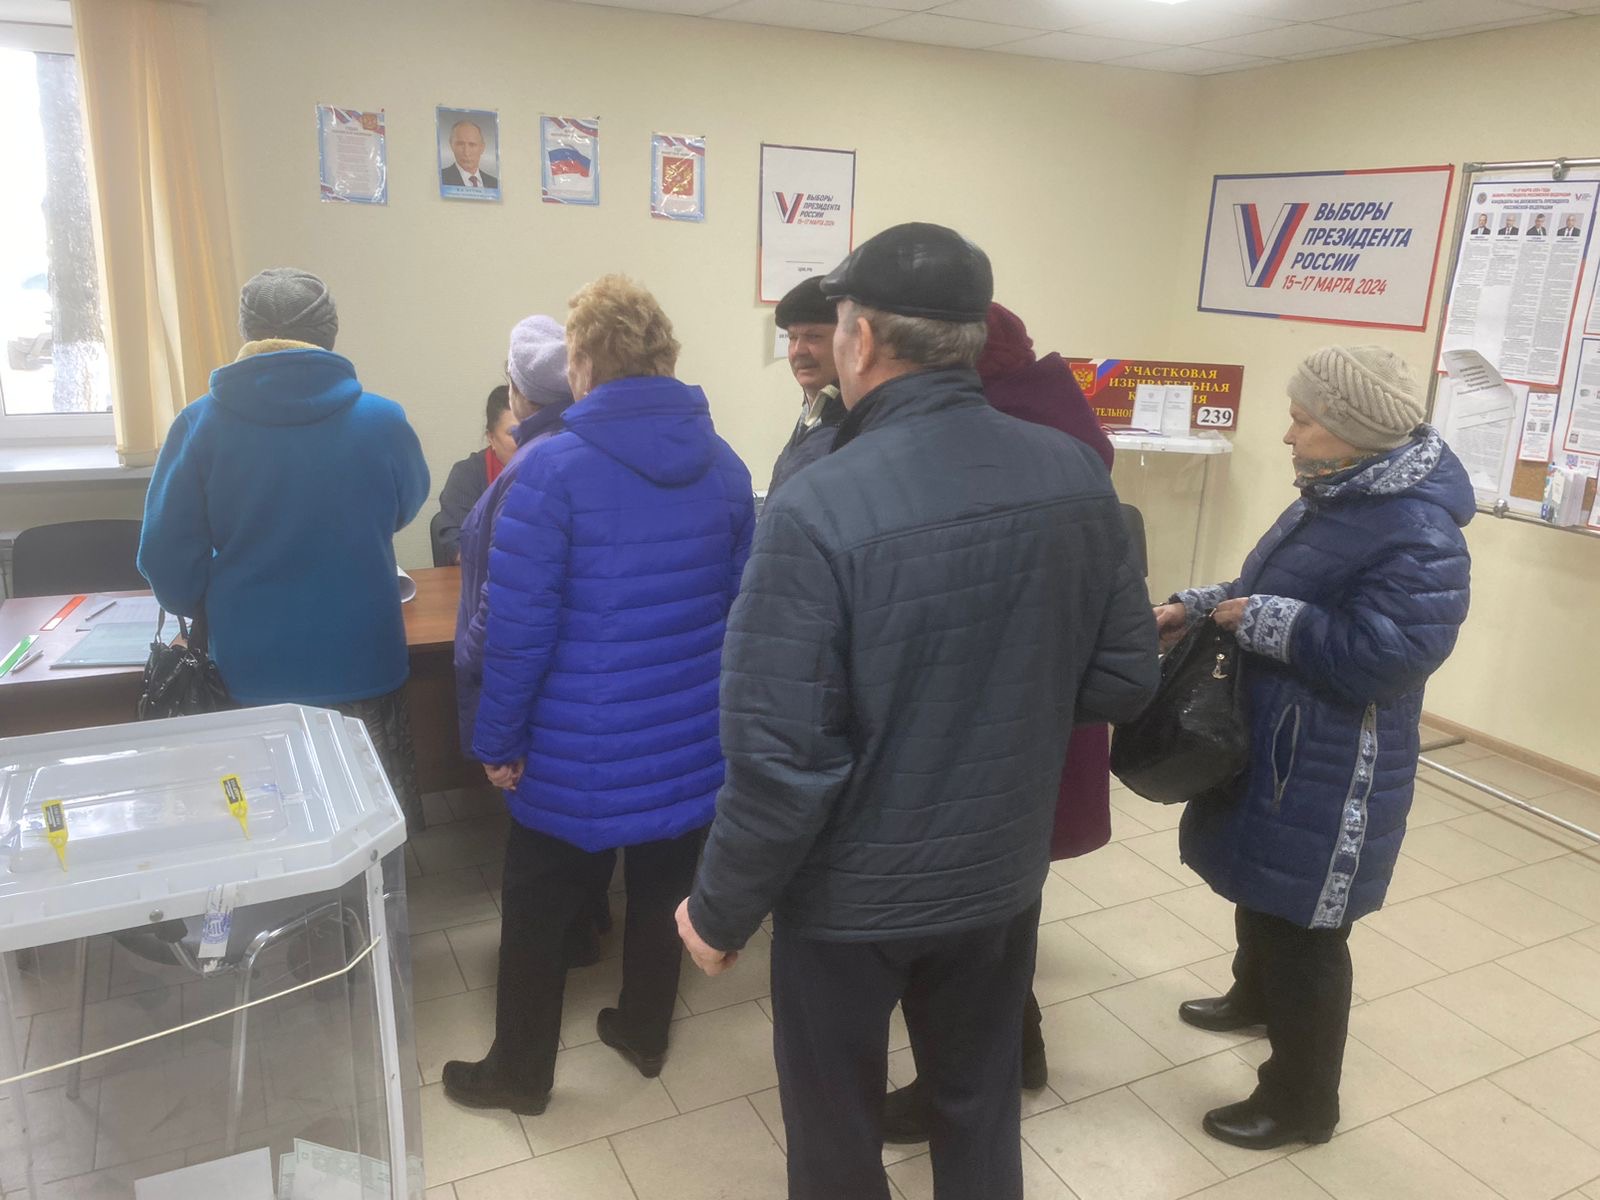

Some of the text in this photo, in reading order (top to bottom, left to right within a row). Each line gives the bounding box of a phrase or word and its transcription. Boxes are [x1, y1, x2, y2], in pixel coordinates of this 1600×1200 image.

[803, 202, 841, 211] ПРЕЗИДЕНТА
[806, 194, 834, 202] ВЫБОРЫ
[800, 210, 825, 218] РОССИИ
[1314, 202, 1393, 221] ВЫБОРЫ
[1302, 228, 1413, 249] ПРЕЗИДЕНТА
[1290, 252, 1360, 272] РОССИИ
[1317, 277, 1354, 294] МАРТА
[1354, 279, 1388, 295] 2024
[1124, 365, 1217, 379] УЧАСТКОВАЯ
[1200, 408, 1232, 425] 239
